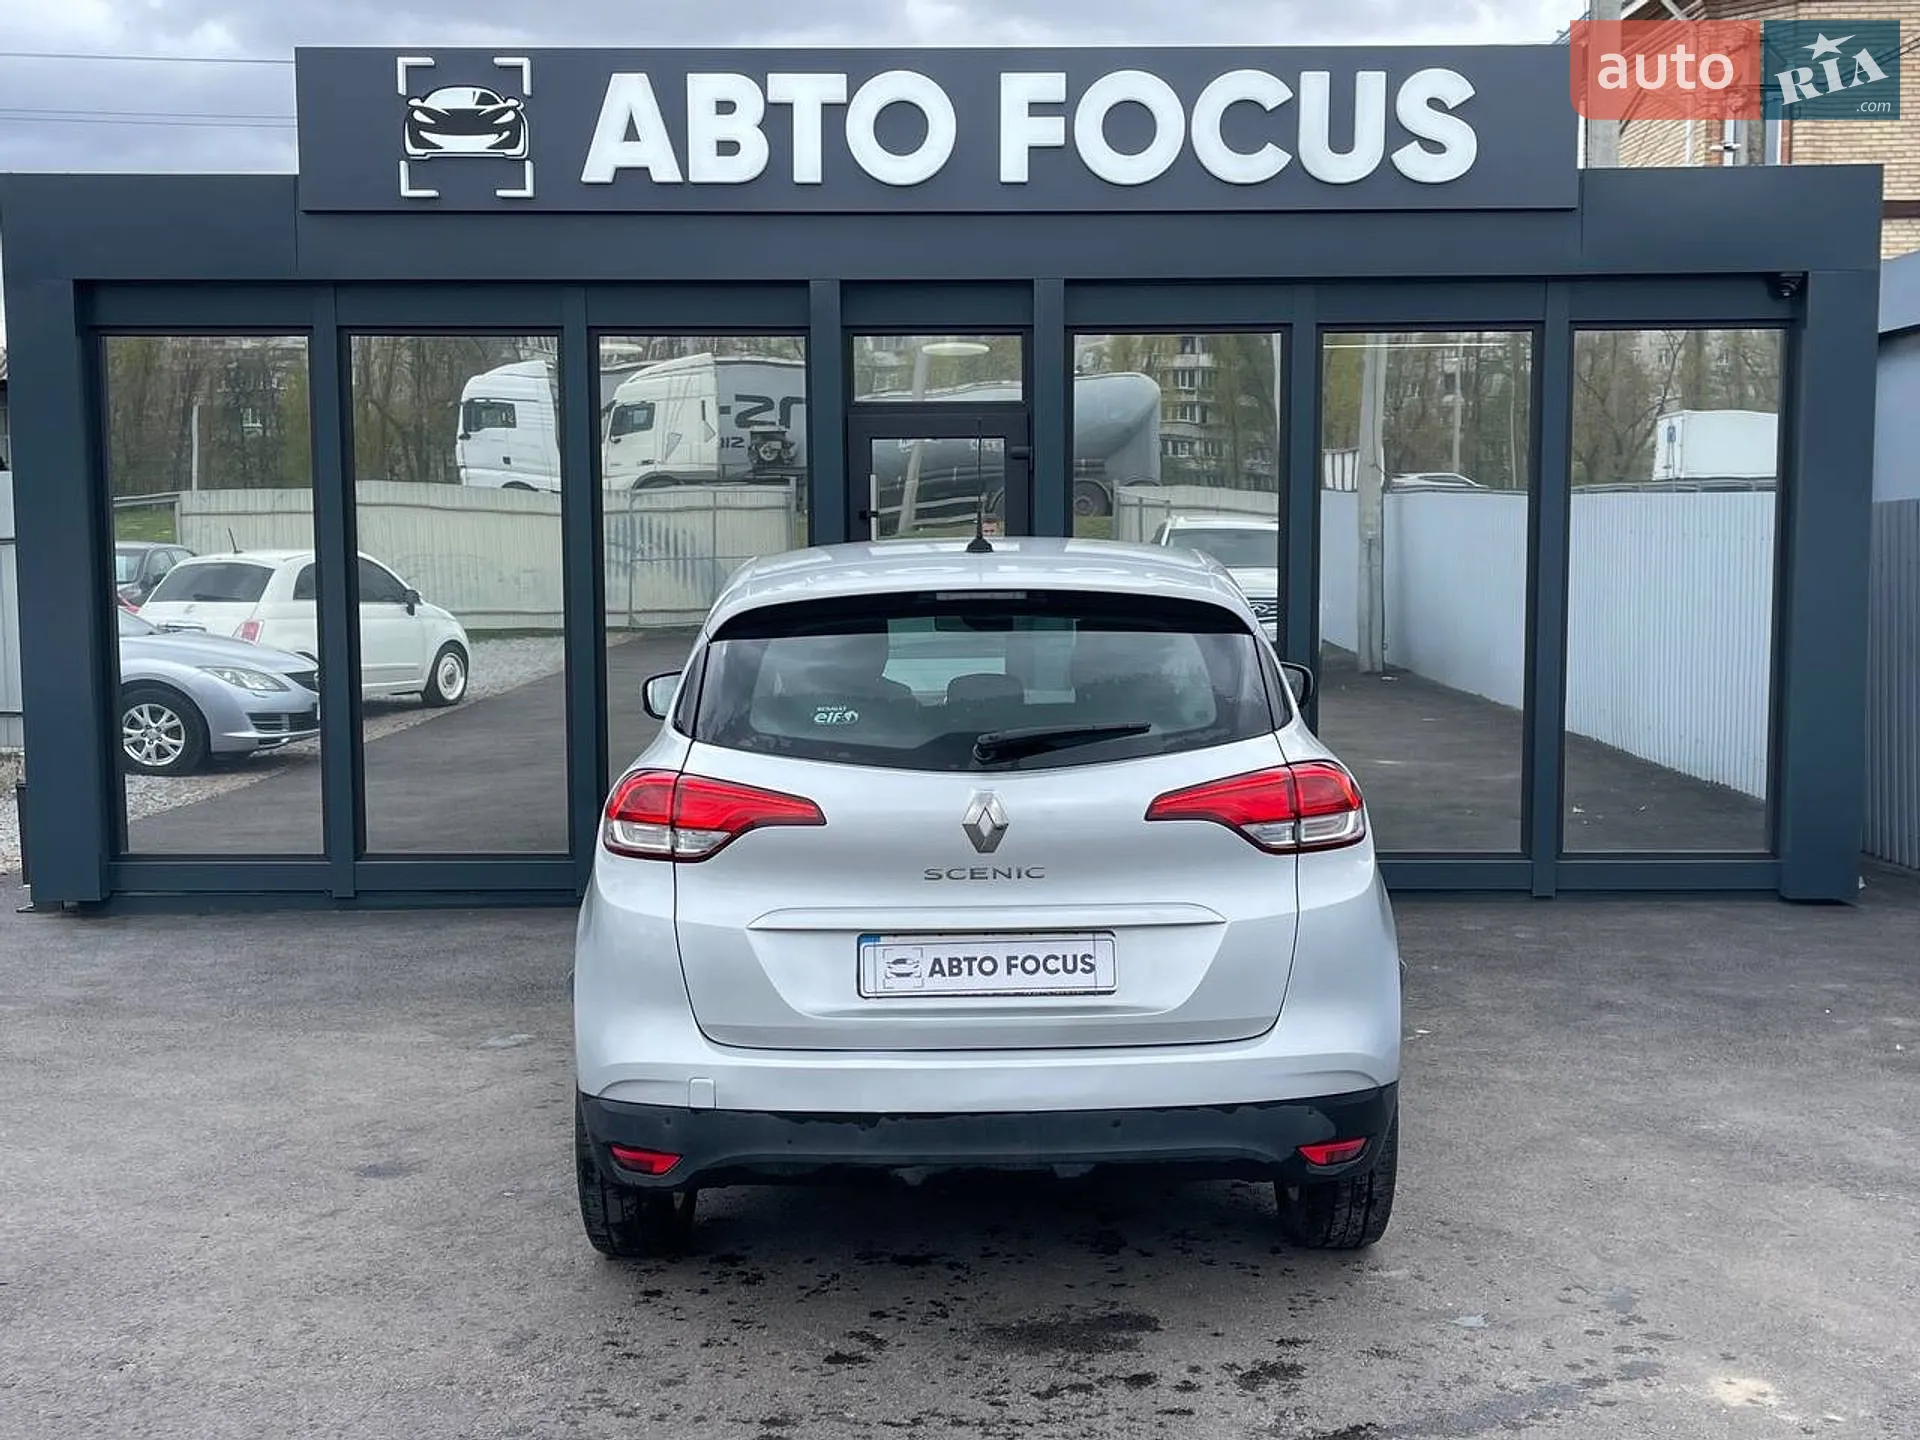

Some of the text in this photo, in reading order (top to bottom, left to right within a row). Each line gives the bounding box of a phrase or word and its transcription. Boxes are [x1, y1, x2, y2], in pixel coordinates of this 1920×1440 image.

[580, 68, 1478, 187] АВТО FOCUS
[924, 866, 1046, 880] SCENIC
[928, 953, 1096, 978] АВТО FOCUS
